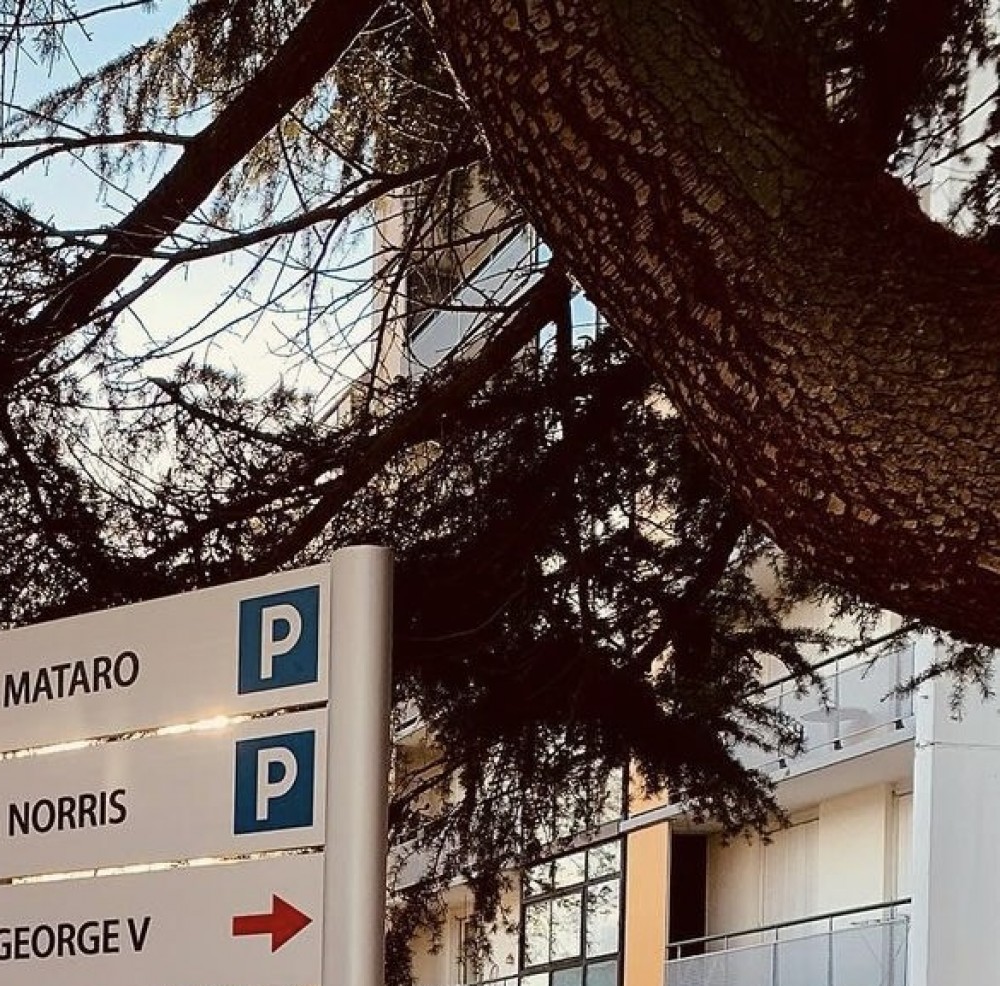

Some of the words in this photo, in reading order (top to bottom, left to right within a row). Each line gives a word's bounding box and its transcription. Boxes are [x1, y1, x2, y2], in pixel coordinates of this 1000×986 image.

[260, 604, 302, 679] P
[3, 650, 140, 708] MATARO
[8, 788, 127, 836] NORRIS
[255, 746, 298, 821] P
[127, 916, 151, 952] V
